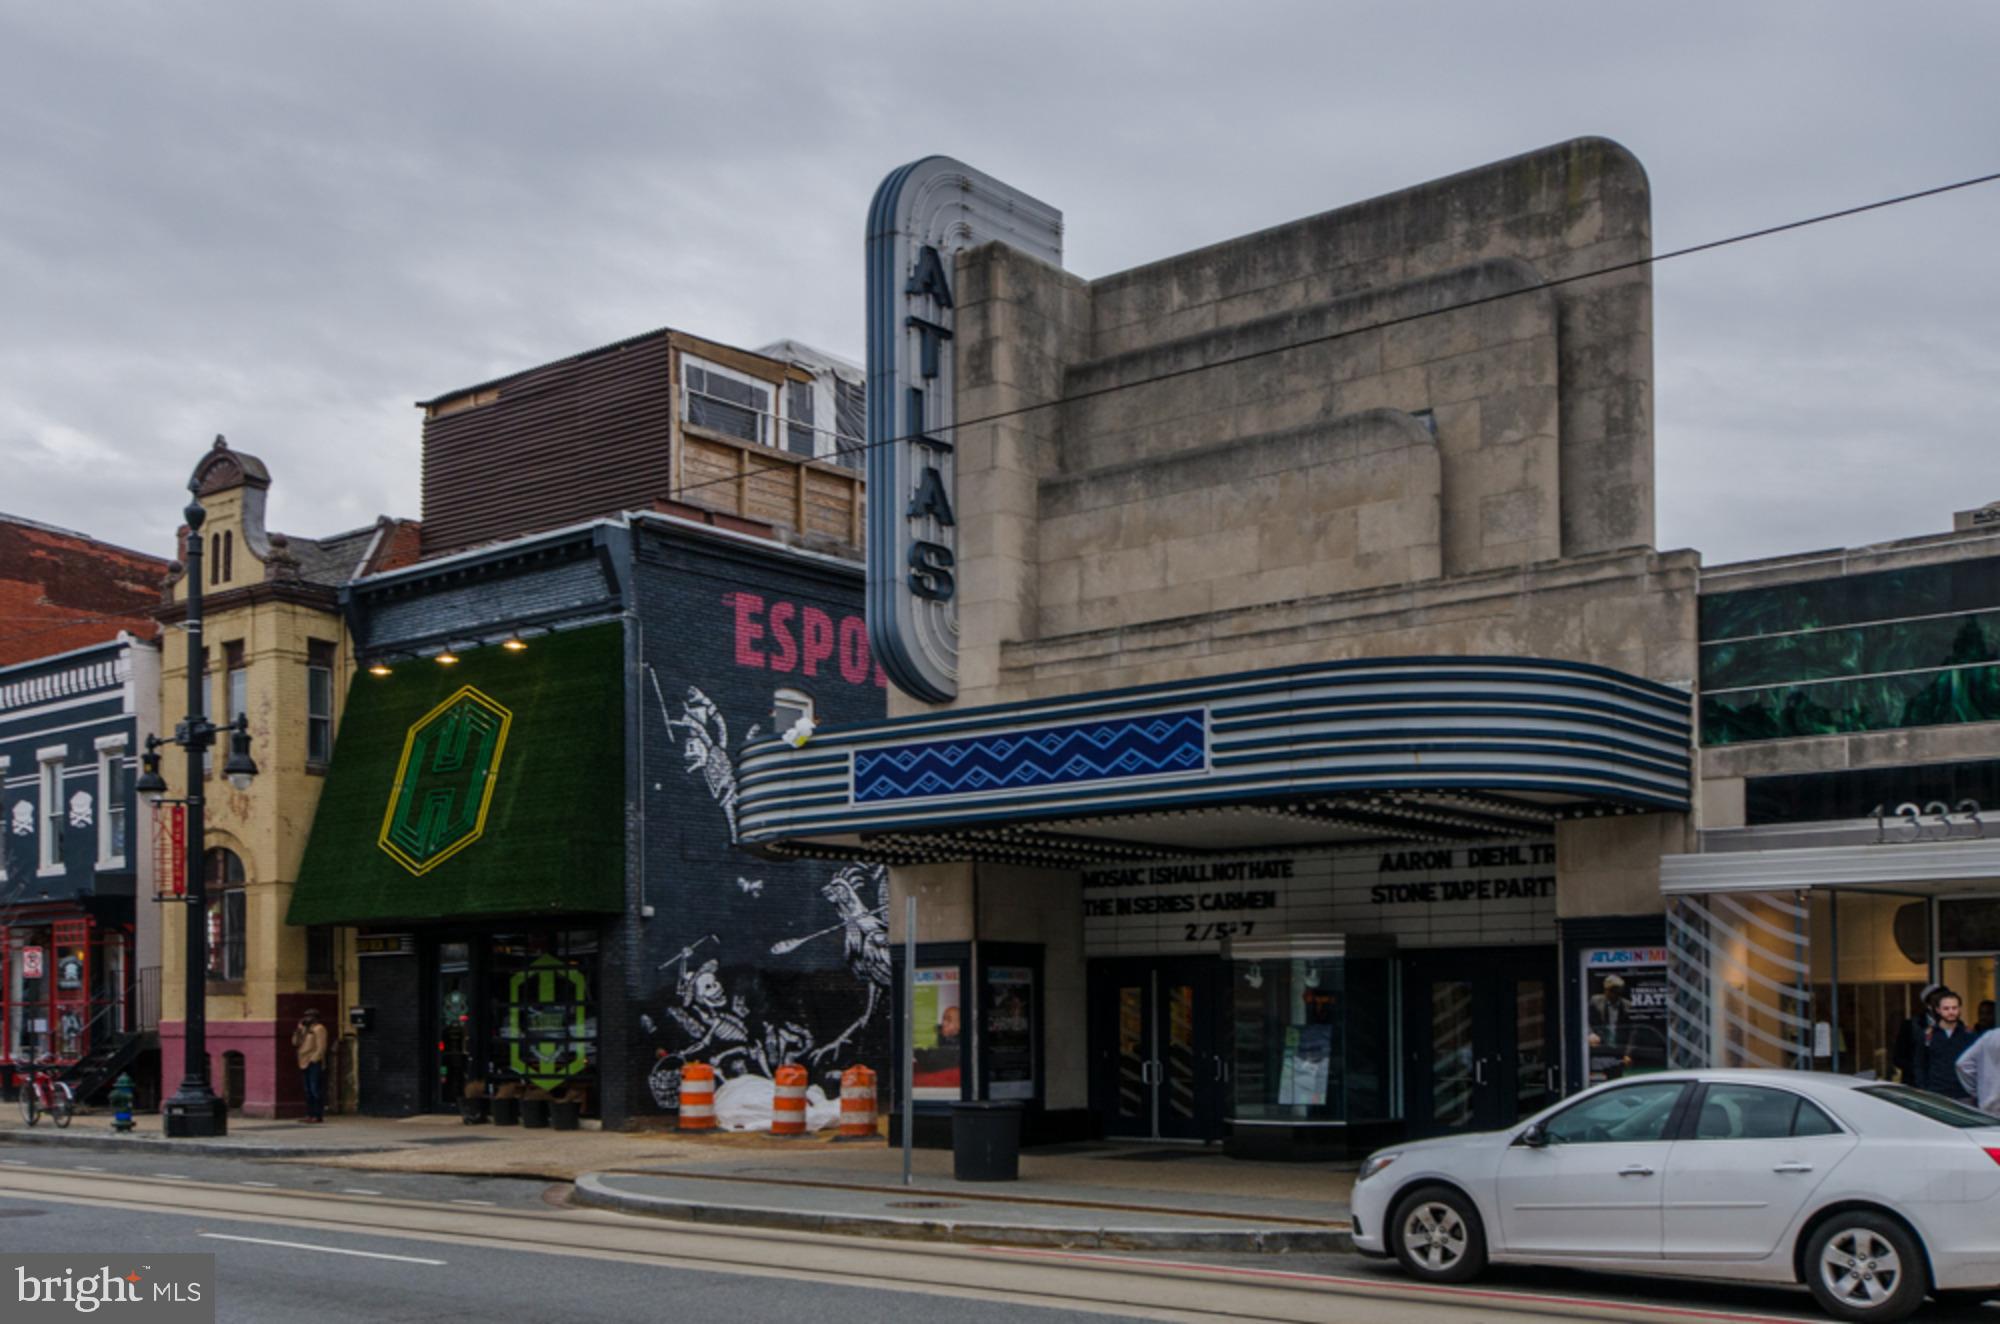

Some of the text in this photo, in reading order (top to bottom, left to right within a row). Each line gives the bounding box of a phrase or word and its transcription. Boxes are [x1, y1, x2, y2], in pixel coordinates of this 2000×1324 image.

[905, 245, 954, 602] ATLAS
[1867, 798, 1984, 842] 1333
[1379, 850, 1452, 871] AARON
[1468, 846, 1526, 867] DIEHL
[1082, 867, 1144, 887] MOSAIC
[1213, 863, 1245, 881] NOT
[1249, 860, 1294, 879] HATE
[1084, 898, 1113, 916] THE
[1134, 895, 1195, 914] SERIES
[1199, 891, 1276, 911] CARMEN
[1372, 883, 1436, 904] STONE
[1440, 879, 1490, 900] TAPE
[1631, 993, 1667, 1007] HAT
